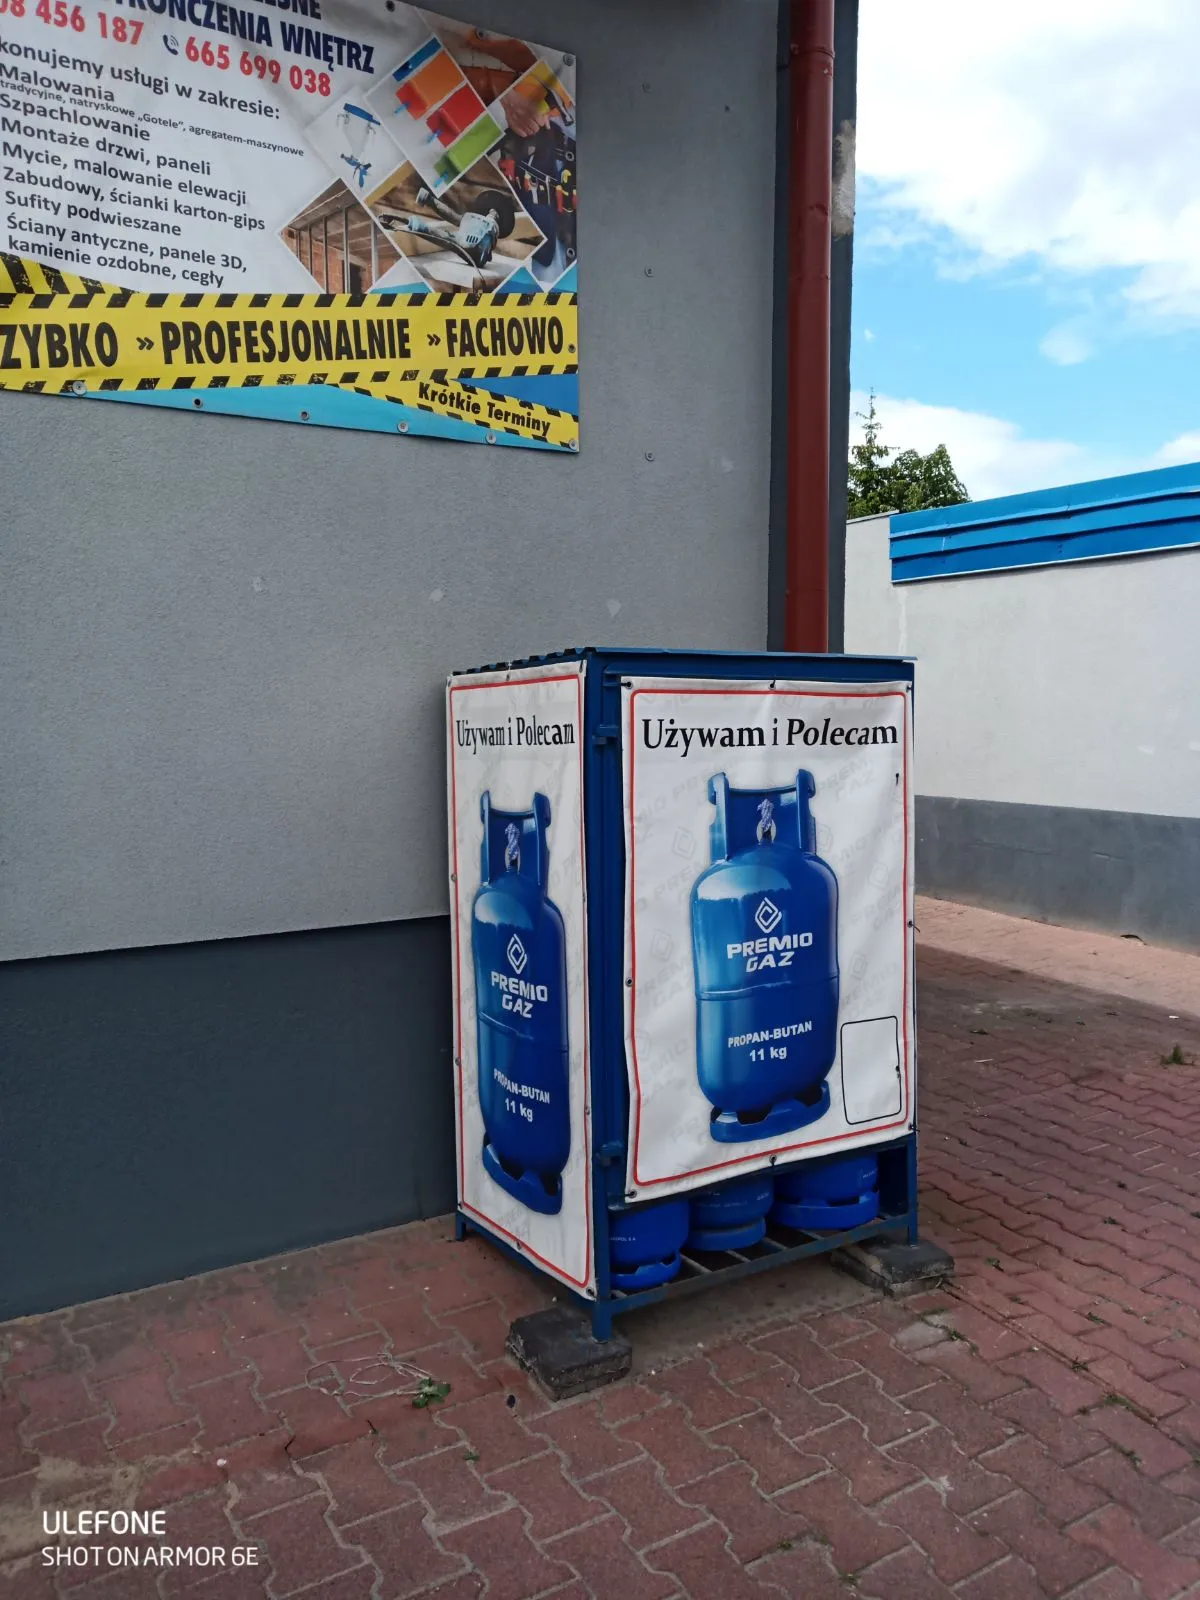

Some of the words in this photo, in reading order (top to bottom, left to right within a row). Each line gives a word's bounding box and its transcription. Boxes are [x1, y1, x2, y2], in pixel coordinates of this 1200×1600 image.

[36, 0, 85, 32] 456
[97, 12, 144, 45] 187
[185, 36, 230, 70] 665
[239, 51, 281, 84] 699
[289, 65, 331, 97] 038
[280, 21, 375, 74] WNĘTRZ
[0, 63, 115, 102] Malowania
[110, 66, 169, 94] usługi
[175, 82, 192, 99] w
[198, 90, 280, 119] zakresie:
[0, 93, 150, 141] Szpachlowanie
[69, 97, 136, 118] natryskowe
[188, 125, 305, 157] agregatem-maszynowe
[1, 117, 89, 148] Montaże
[96, 137, 150, 165] drzwi,
[156, 154, 211, 175] paneli
[2, 142, 68, 169] Mycie,
[74, 155, 173, 189] malowanie
[178, 179, 247, 205] elewacji
[4, 166, 105, 202] Zabudowy,
[110, 188, 169, 212] ścianki
[174, 199, 265, 231] karton-gips
[5, 190, 61, 215] Sufity
[67, 198, 182, 236] podwieszane
[6, 212, 66, 242] Ściany
[71, 229, 154, 256] antyczne,
[159, 244, 216, 267] panele
[221, 254, 247, 273] 3D,
[8, 235, 91, 265] kamienie
[97, 252, 177, 280] ozdobne,
[181, 267, 224, 288] cegły
[0, 322, 118, 369] ZYBKO
[160, 318, 411, 364] PROFESJONALNIE
[445, 316, 563, 358] FACHOWO
[418, 381, 481, 414] Krótkie
[487, 402, 551, 436] Terminy
[456, 719, 506, 755] Używam
[508, 717, 513, 746] i
[516, 715, 576, 746] Polecam
[642, 718, 766, 758] Używam
[771, 717, 780, 746] i
[786, 717, 899, 746] Polecam
[726, 932, 813, 959] PREMIO
[745, 951, 795, 973] GAZ
[491, 970, 548, 1002] PREMIO
[502, 993, 533, 1018] GAZ
[727, 1020, 813, 1048] PROPAN-BUTAN
[749, 1048, 765, 1062] 11
[769, 1046, 787, 1060] kg
[493, 1068, 551, 1105] PROPAN-BUTAN
[505, 1097, 516, 1113] 11
[519, 1102, 534, 1122] kg
